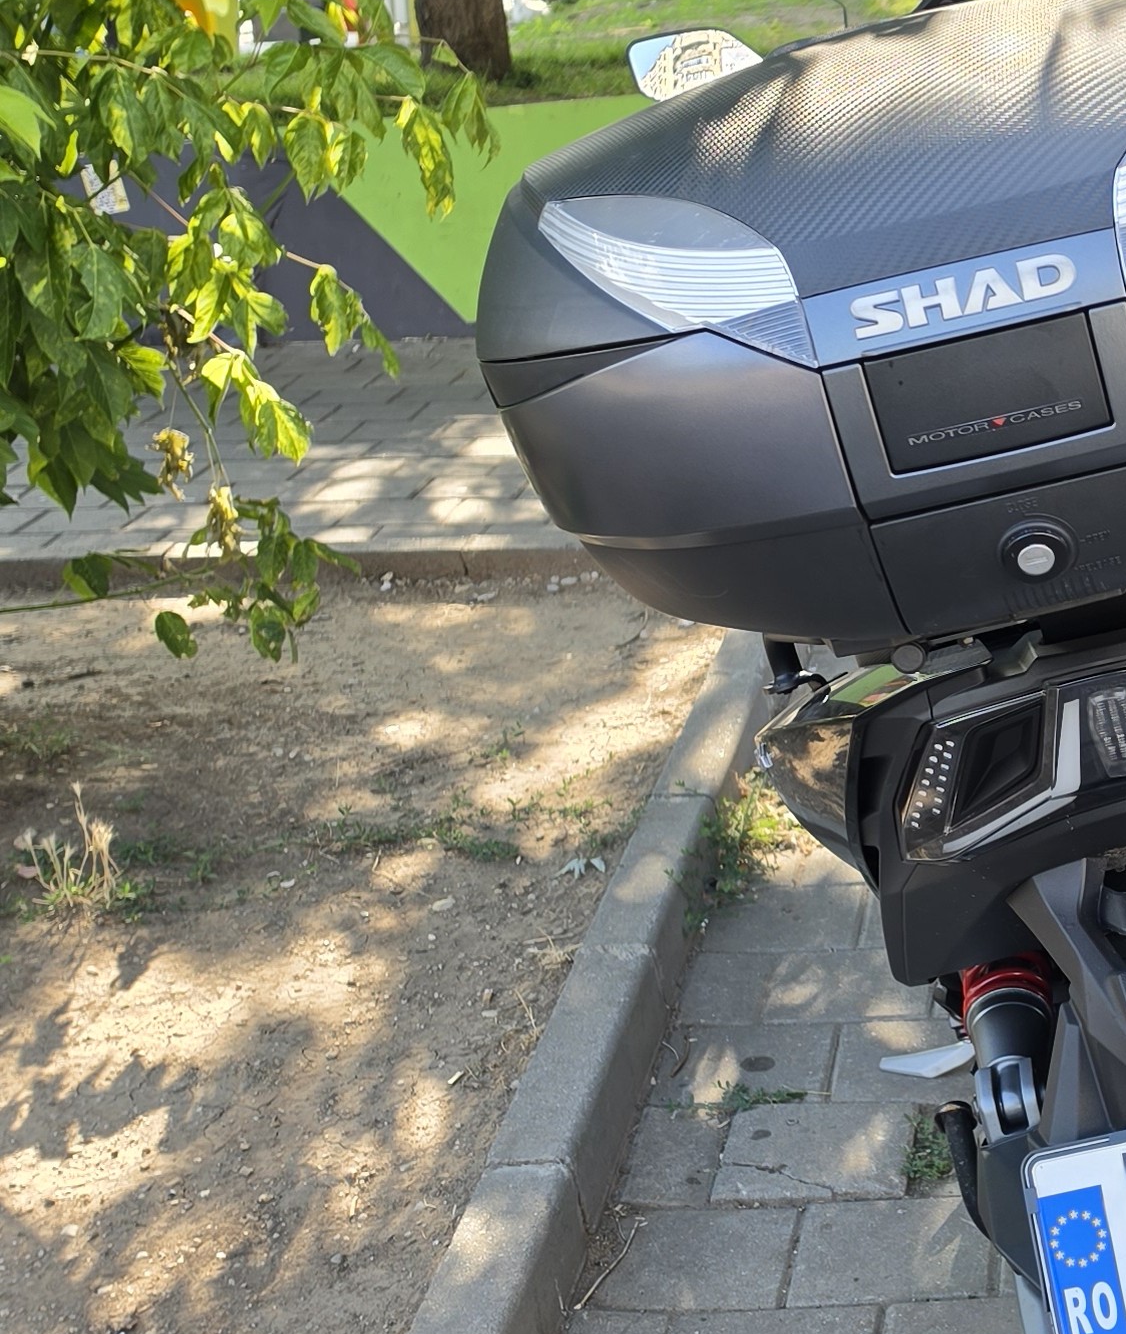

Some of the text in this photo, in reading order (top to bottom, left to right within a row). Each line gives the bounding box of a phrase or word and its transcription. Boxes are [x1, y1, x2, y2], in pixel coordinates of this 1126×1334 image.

[850, 253, 1078, 340] SHAD
[907, 400, 1082, 446] MOTOR CASES
